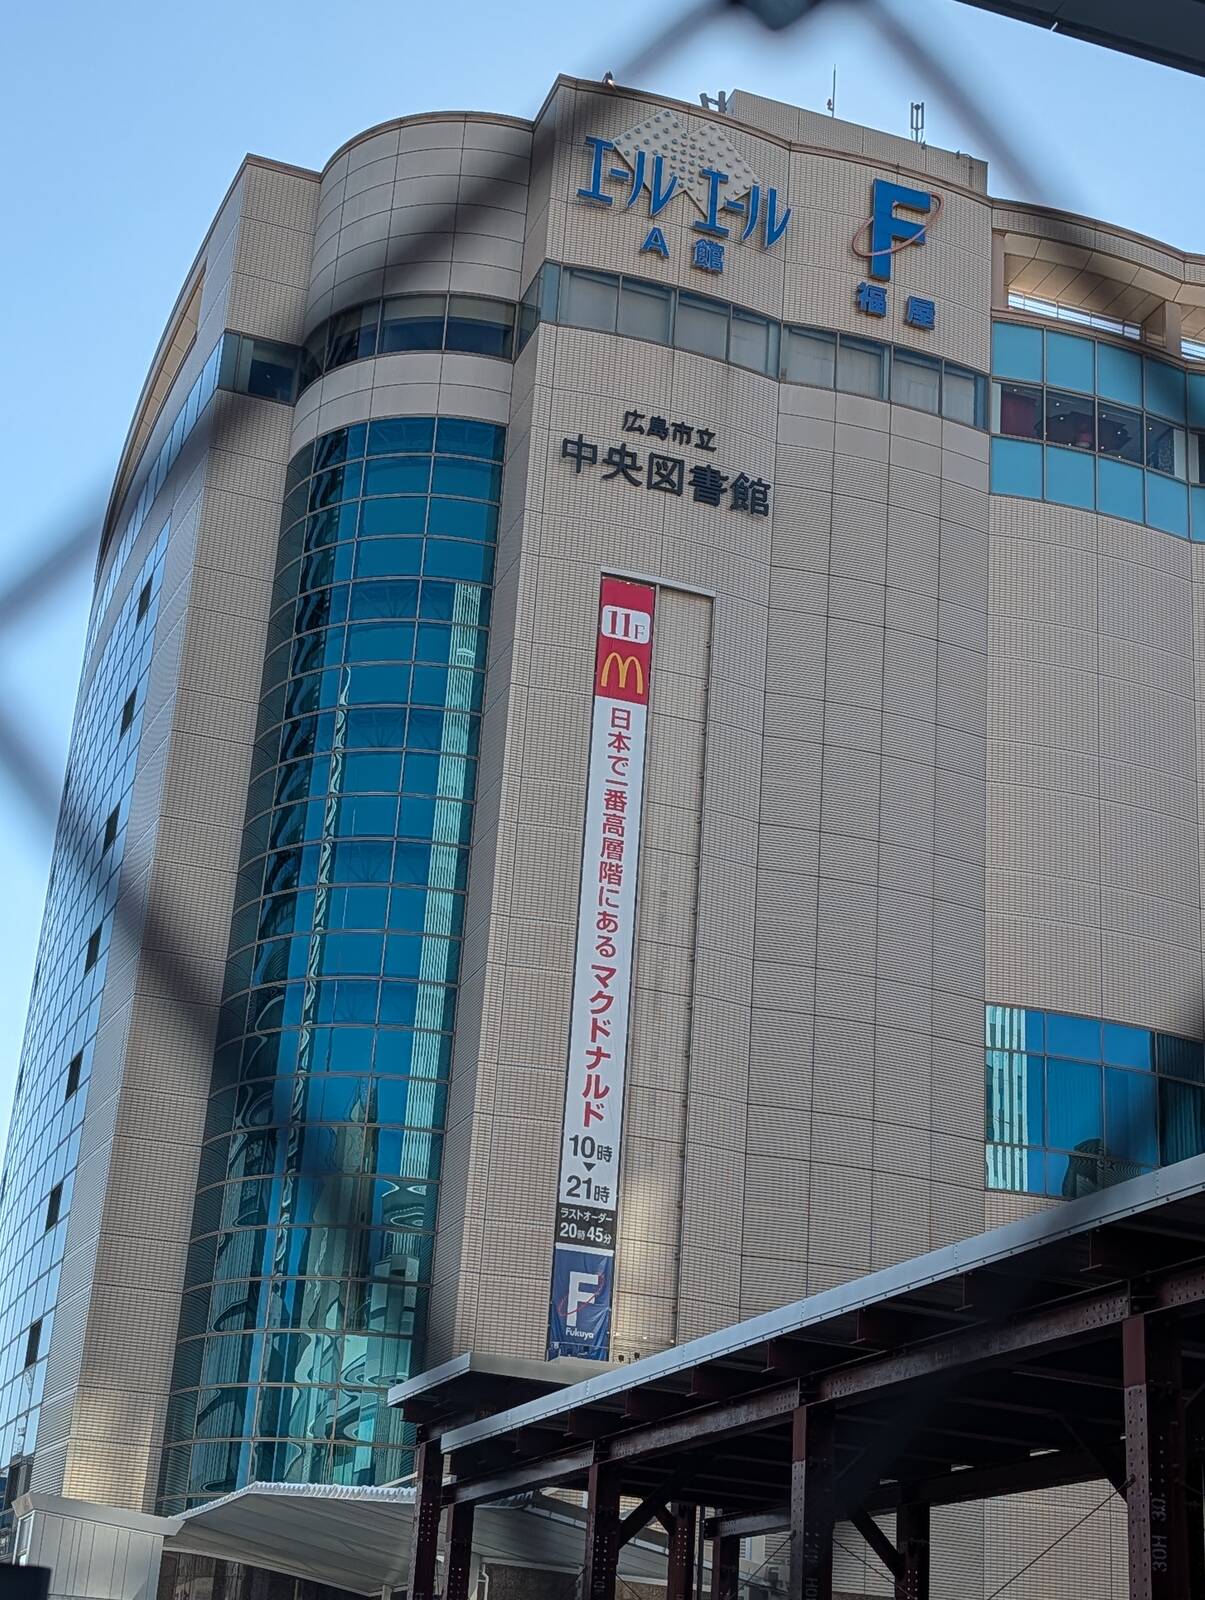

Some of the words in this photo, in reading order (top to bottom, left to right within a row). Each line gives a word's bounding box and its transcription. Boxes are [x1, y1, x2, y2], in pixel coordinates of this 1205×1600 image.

[870, 178, 932, 281] F
[856, 282, 936, 331] 福屋
[623, 408, 718, 453] 広島市立
[561, 433, 772, 517] 中央図書館
[606, 610, 647, 640] 11F
[568, 1134, 613, 1164] 10時
[566, 1174, 610, 1204] 21時
[560, 1207, 613, 1224] ラストオーダー
[566, 1271, 599, 1327] F
[565, 1327, 595, 1341] Fukuya
